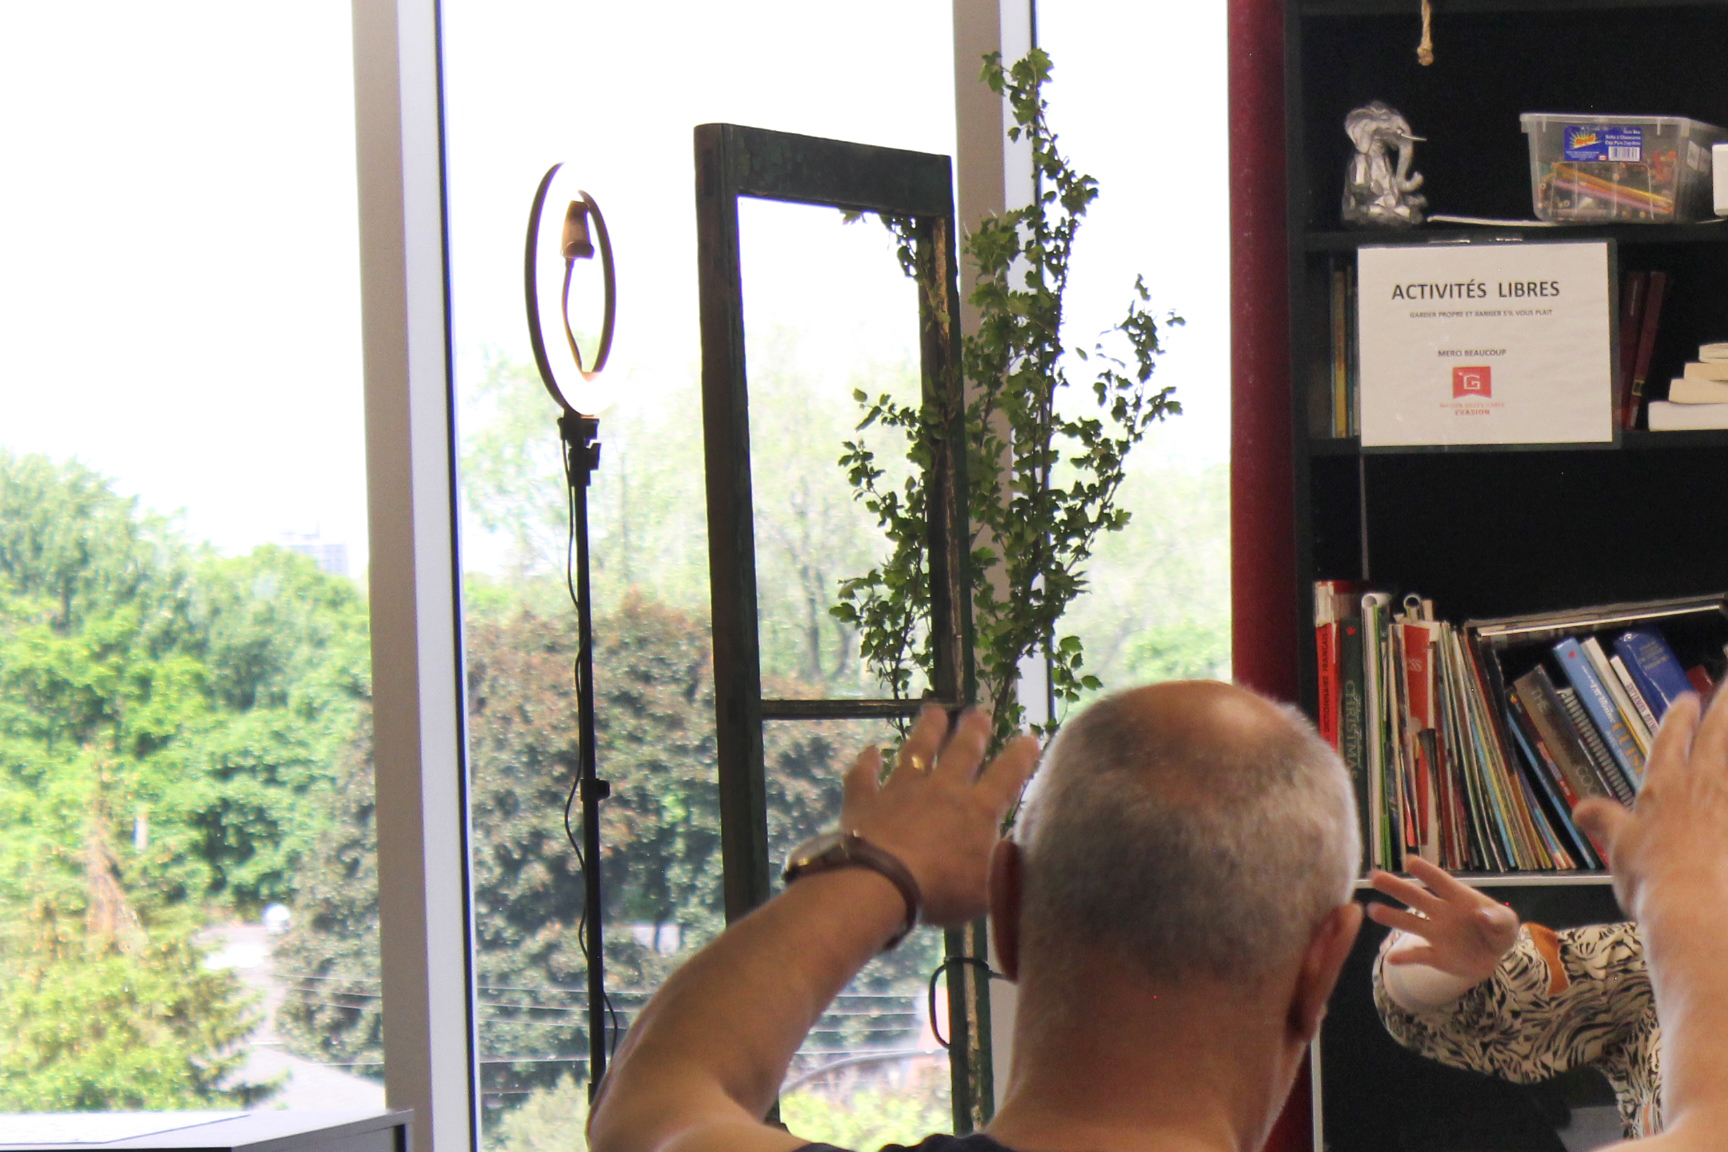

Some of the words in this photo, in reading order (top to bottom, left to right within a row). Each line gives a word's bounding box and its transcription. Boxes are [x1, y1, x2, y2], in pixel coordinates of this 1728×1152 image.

[1392, 279, 1487, 300] ACTIVITÉS
[1498, 281, 1560, 299] LIBRES
[1410, 311, 1437, 319] GARDER
[1464, 349, 1507, 357] BEAUCOUP
[1530, 689, 1551, 715] THE
